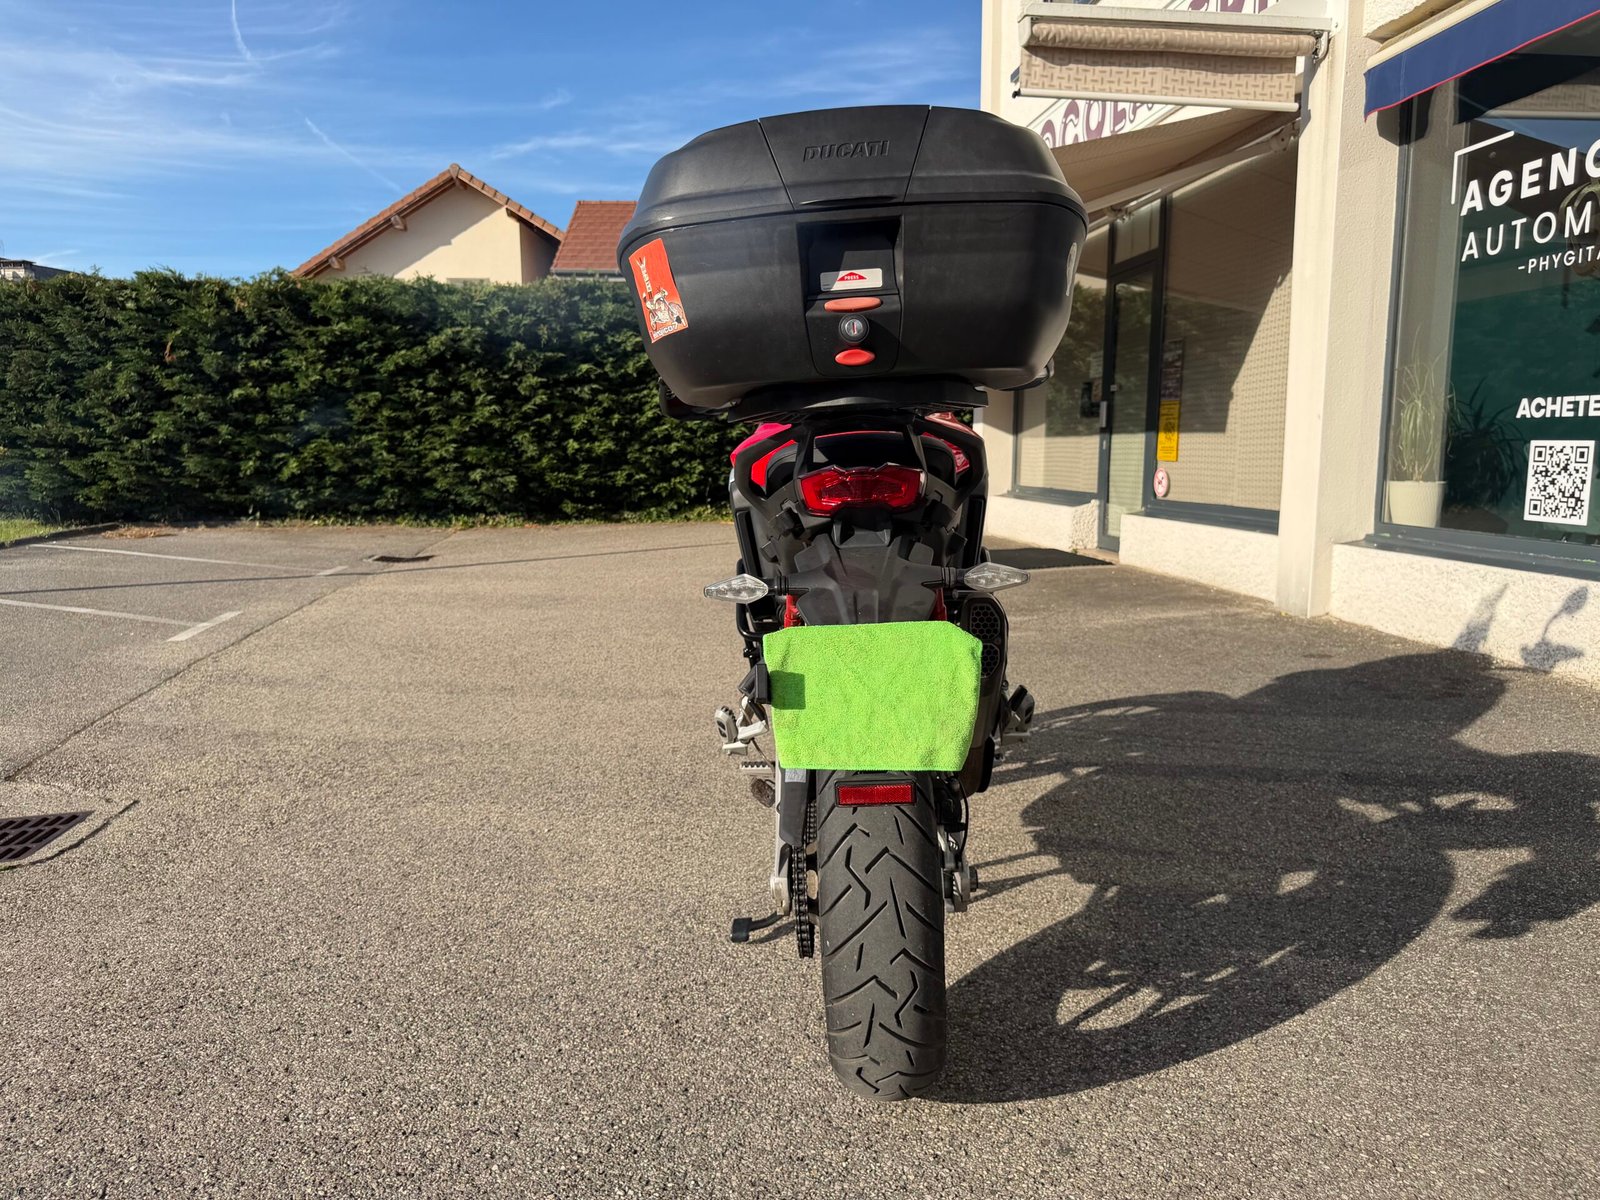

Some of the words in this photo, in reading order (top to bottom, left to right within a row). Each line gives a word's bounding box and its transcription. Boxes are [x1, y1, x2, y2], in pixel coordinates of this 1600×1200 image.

[803, 140, 889, 162] DUCATI
[1460, 139, 1600, 216] AGENC
[1461, 200, 1592, 262] AUTOM
[1518, 245, 1600, 274] -PHYGIT
[1515, 394, 1600, 419] ACHETE
